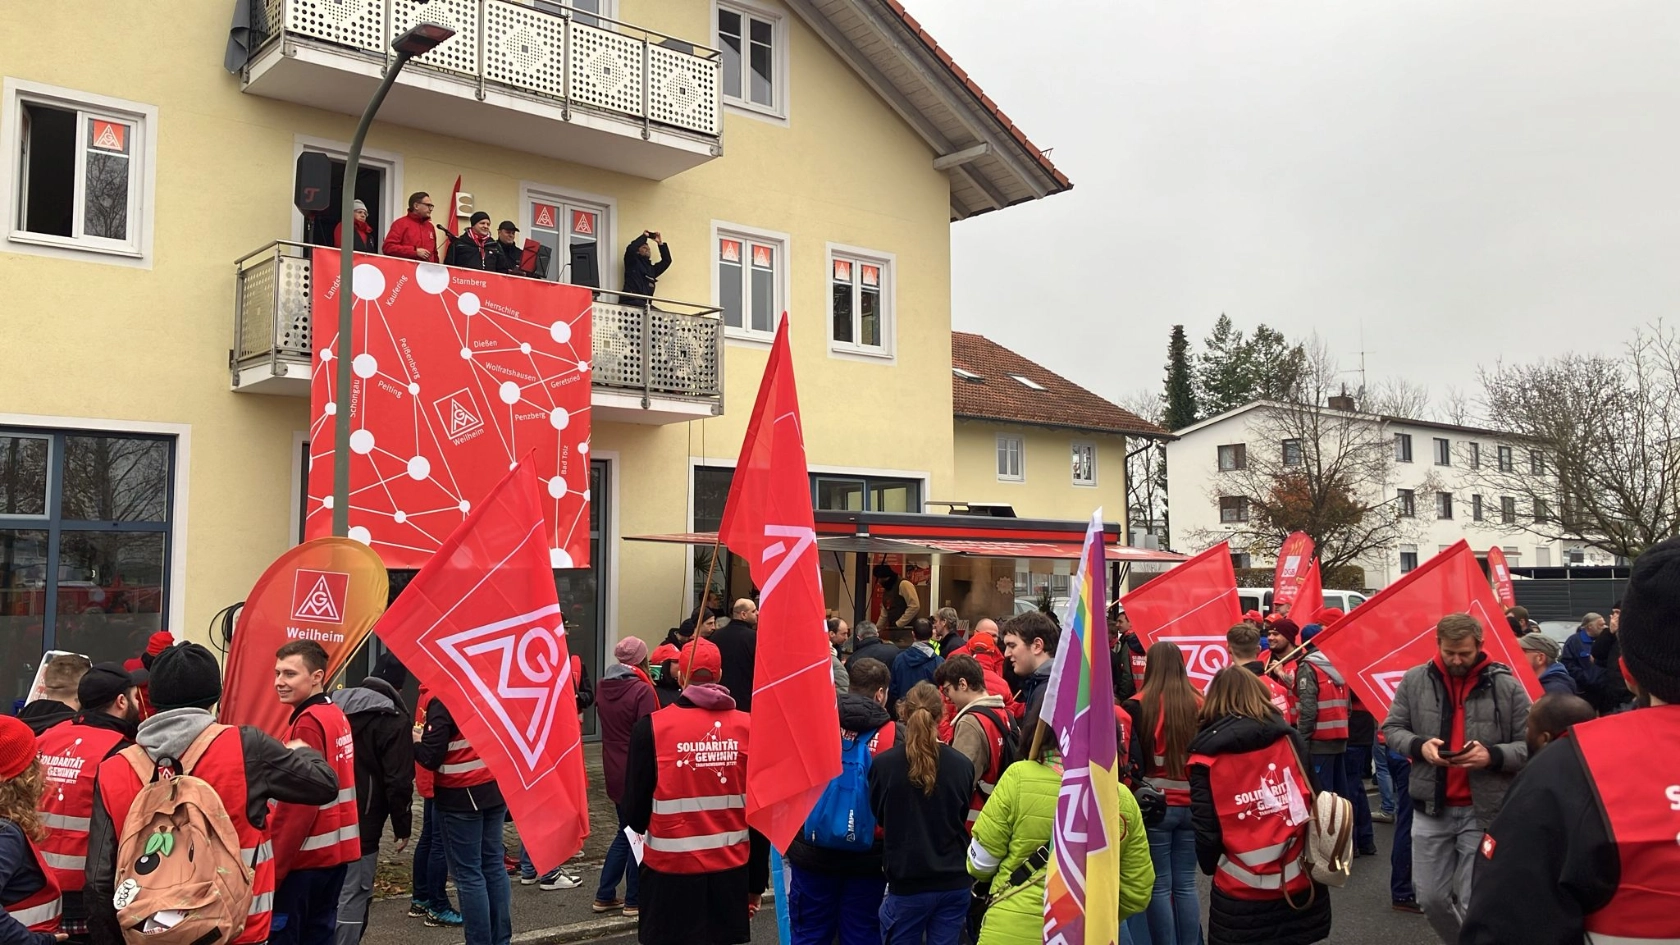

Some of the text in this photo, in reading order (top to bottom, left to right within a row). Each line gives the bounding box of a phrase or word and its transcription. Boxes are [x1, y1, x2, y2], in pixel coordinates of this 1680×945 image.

[385, 274, 409, 307] Kaufering
[452, 276, 487, 288] Starnberg
[484, 299, 520, 318] Herrsching
[473, 339, 498, 348] Dießen
[399, 337, 421, 380] Peißenberg
[485, 361, 537, 382] Wolfratshausen
[550, 374, 581, 389] Geretsried
[349, 379, 361, 418] Schongau
[514, 411, 546, 421] Penzberg
[452, 427, 485, 446] Weilheim
[286, 626, 345, 643] Weilheim
[677, 738, 739, 753] SOLIDARITÄT
[695, 751, 739, 763] GEWINNT
